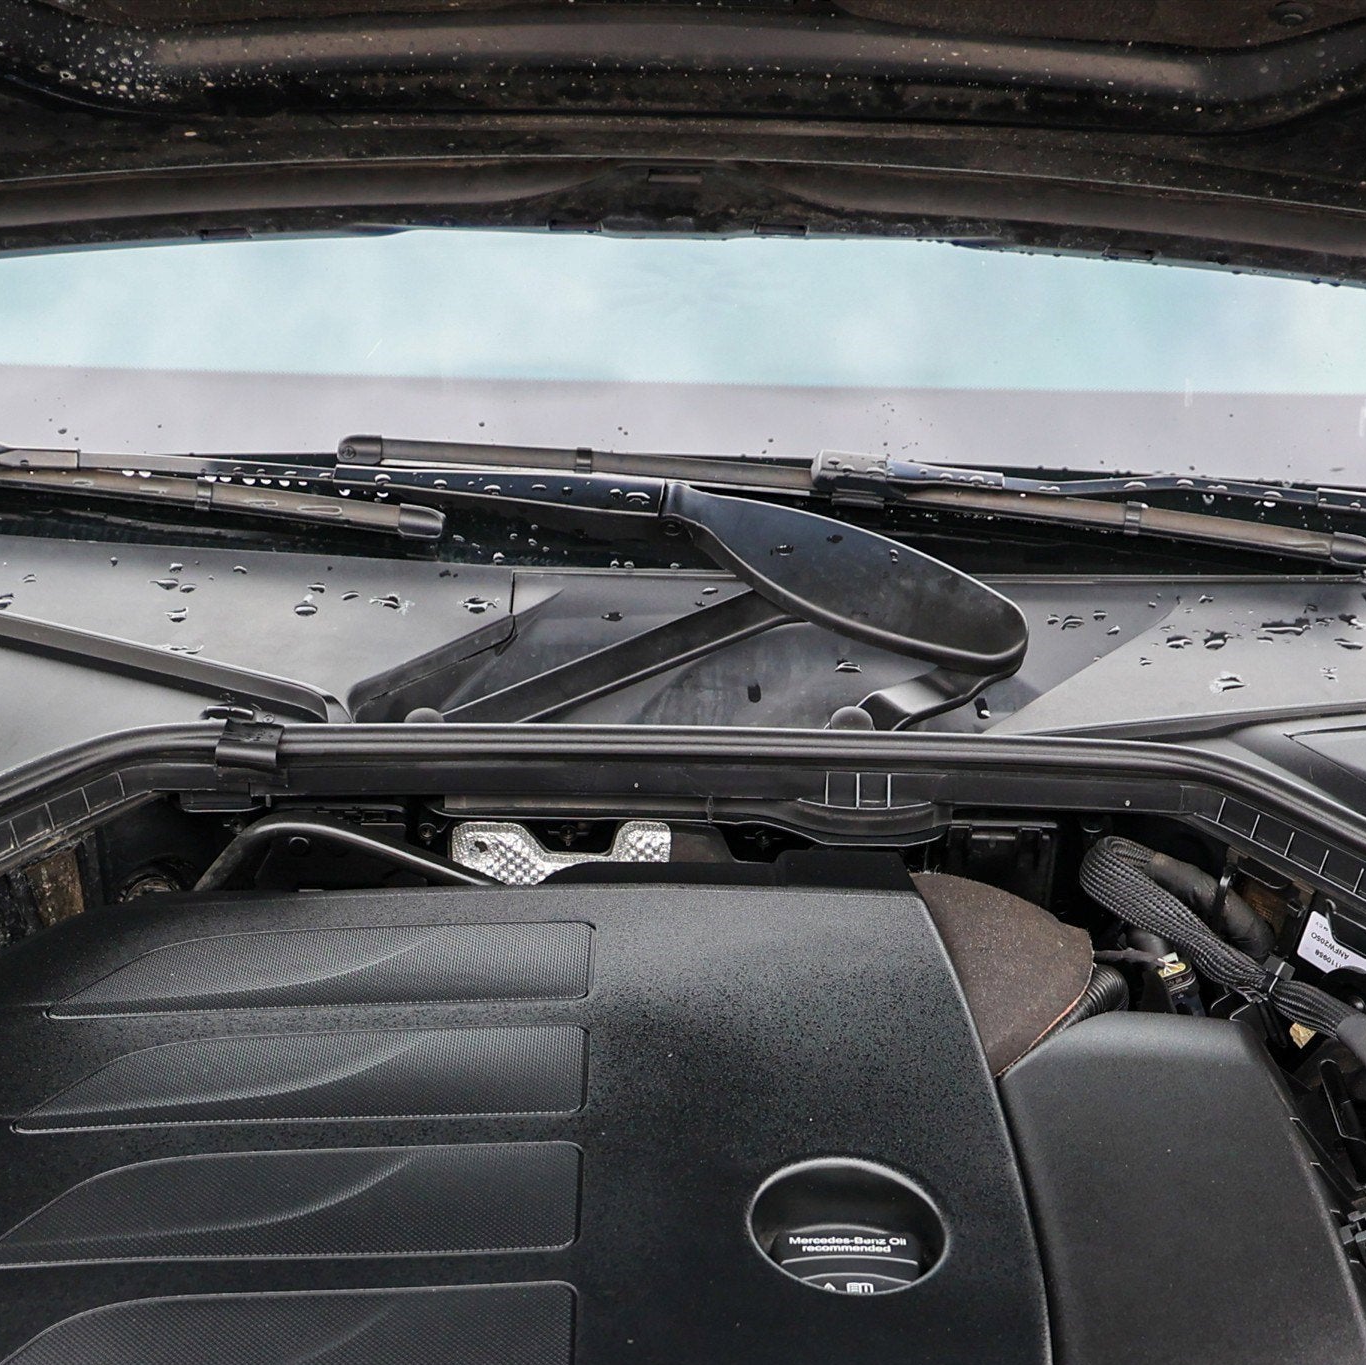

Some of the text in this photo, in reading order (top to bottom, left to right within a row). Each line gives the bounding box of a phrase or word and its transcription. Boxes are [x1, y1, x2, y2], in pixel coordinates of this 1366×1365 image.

[789, 1236, 907, 1246] Mercedes-Benz Oil
[801, 1245, 892, 1253] recommended
